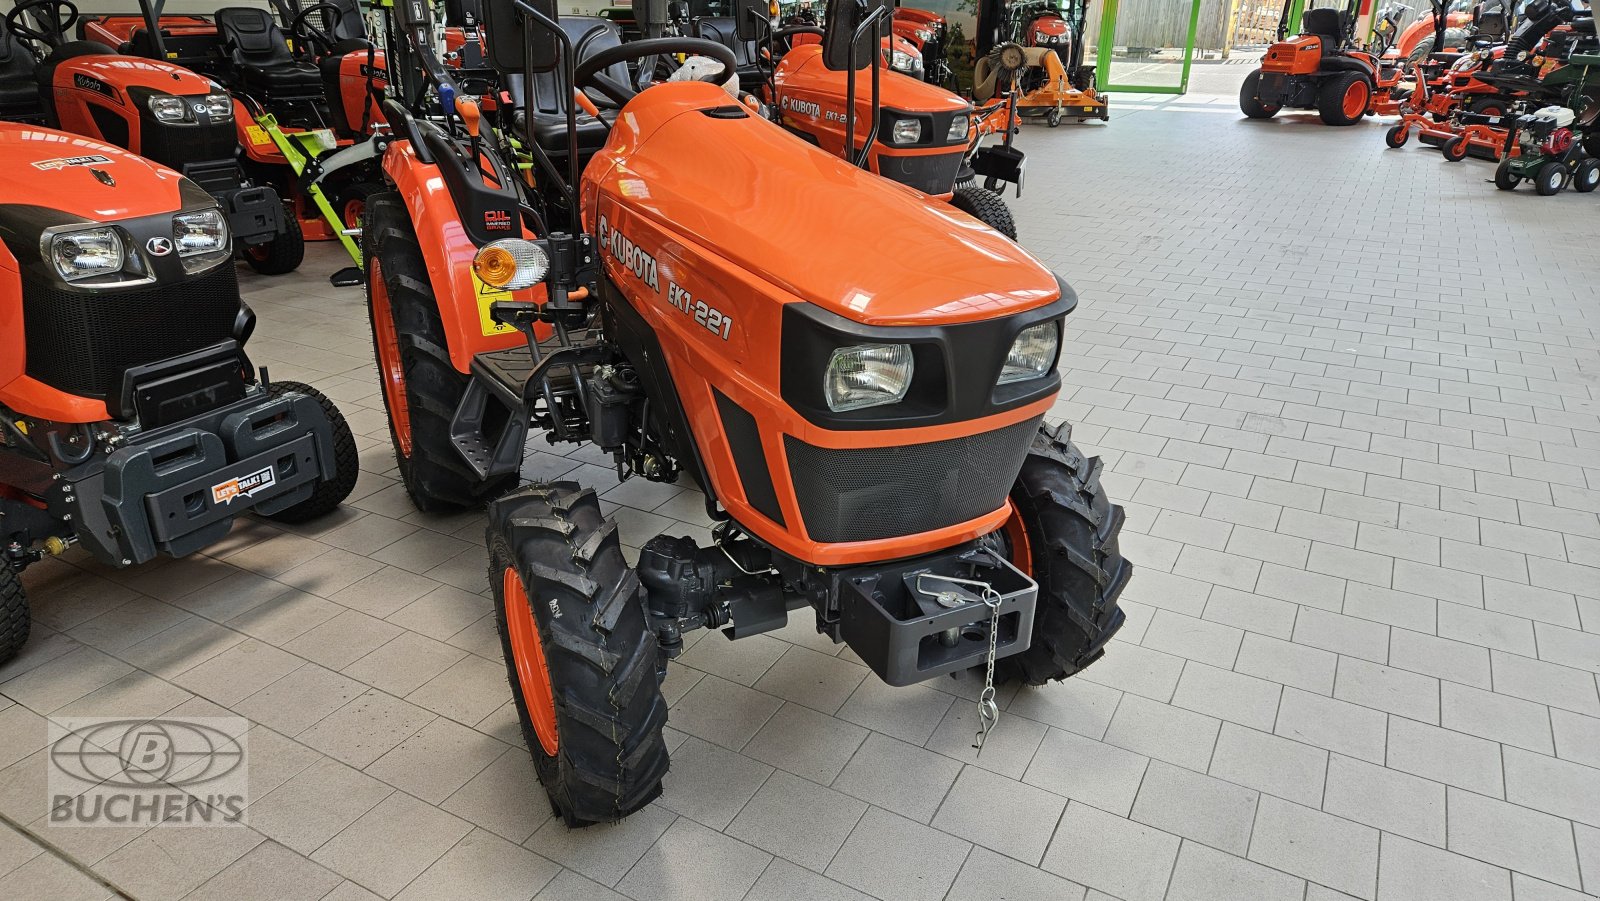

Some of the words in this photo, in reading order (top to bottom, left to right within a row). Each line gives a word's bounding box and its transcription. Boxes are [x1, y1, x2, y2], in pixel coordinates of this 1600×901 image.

[77, 75, 101, 90] Kubota
[790, 98, 820, 117] KUBOTA
[825, 110, 857, 125] EK1-21
[485, 210, 511, 221] OIL
[610, 227, 660, 294] KUBOTA
[667, 280, 733, 341] EK1-221
[216, 484, 237, 499] LET'S
[237, 474, 260, 490] TALK!
